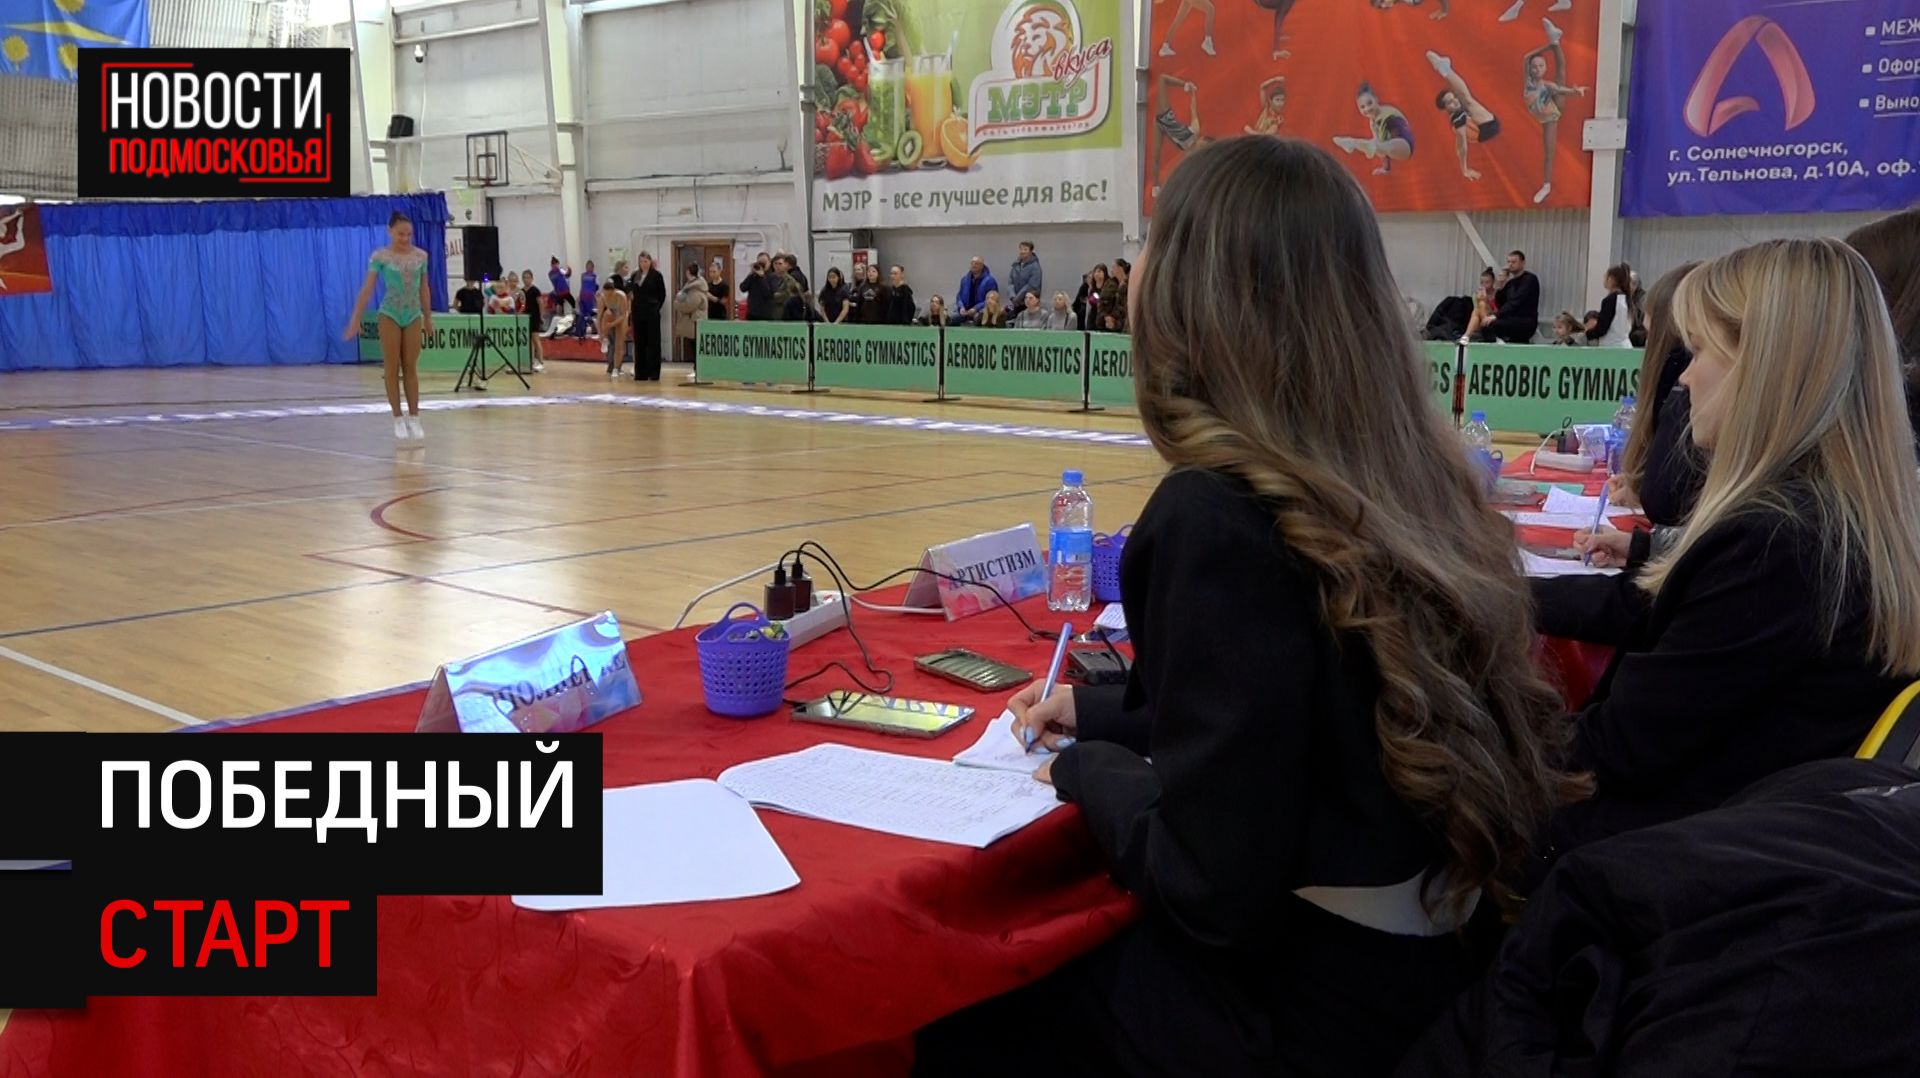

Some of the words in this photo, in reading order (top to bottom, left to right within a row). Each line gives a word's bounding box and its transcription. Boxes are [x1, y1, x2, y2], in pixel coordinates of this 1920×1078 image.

[1053, 37, 1112, 83] вкуса
[987, 77, 1088, 123] МЭТР
[1669, 149, 1681, 161] г.
[1687, 141, 1849, 161] Солнечногорск,
[1804, 160, 1870, 180] д.10А,
[1877, 158, 1920, 178] оф.
[822, 190, 873, 211] МЭТР
[894, 191, 923, 209] все
[928, 186, 1009, 213] лучшее
[1012, 185, 1054, 208] для
[1060, 180, 1108, 202] Вас!
[699, 333, 740, 358] AEROBIC
[742, 335, 806, 361] GYMNASTICS
[816, 338, 861, 364] AEROBIC
[865, 340, 936, 367] GYMNASTICS
[946, 342, 997, 371] AEROBIC
[1001, 344, 1081, 375] GYMNASTICS
[1468, 363, 1551, 399] AEROBIC
